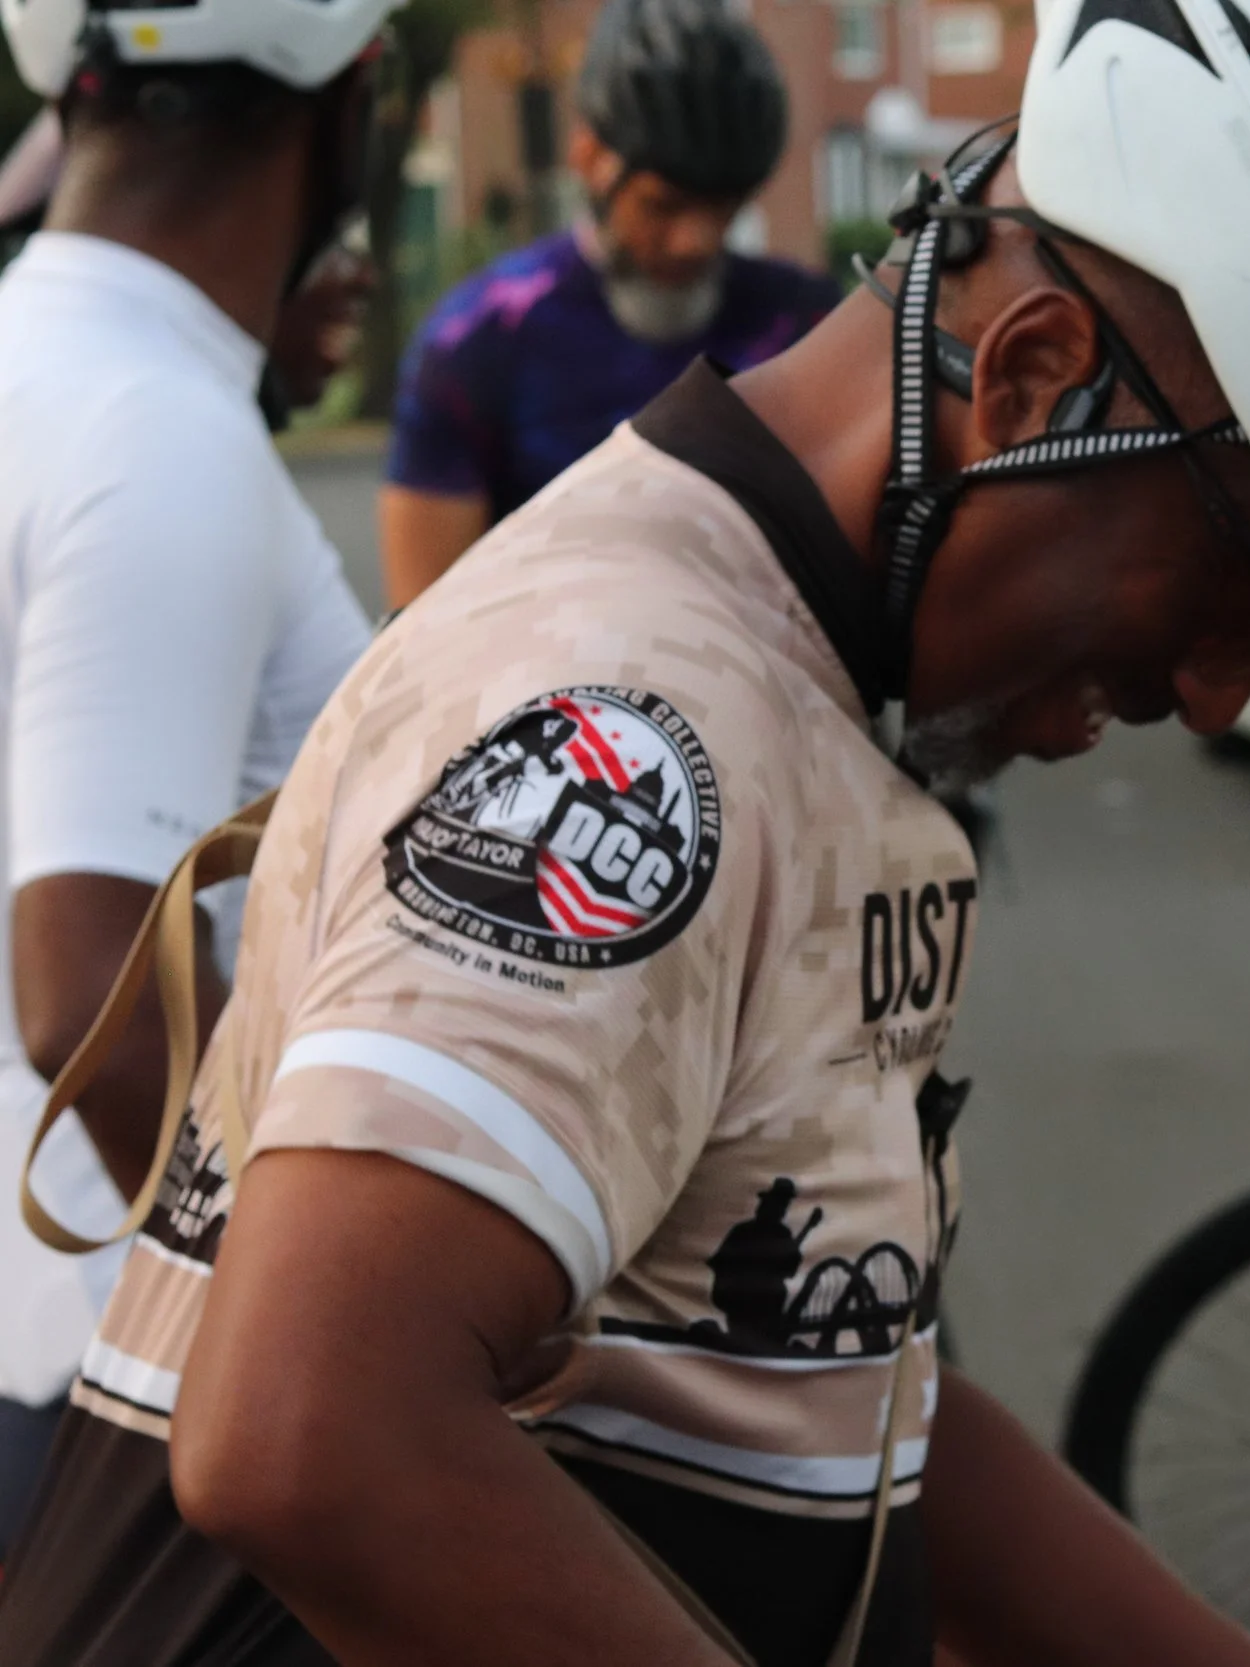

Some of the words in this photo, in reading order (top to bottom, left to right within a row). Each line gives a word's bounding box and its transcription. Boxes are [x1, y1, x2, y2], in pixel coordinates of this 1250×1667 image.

[650, 702, 720, 841] COLLECTIVE
[547, 800, 674, 908] DCC
[474, 952, 493, 974] in
[498, 960, 566, 994] Motion
[553, 943, 592, 964] USA
[860, 878, 976, 1024] DIST
